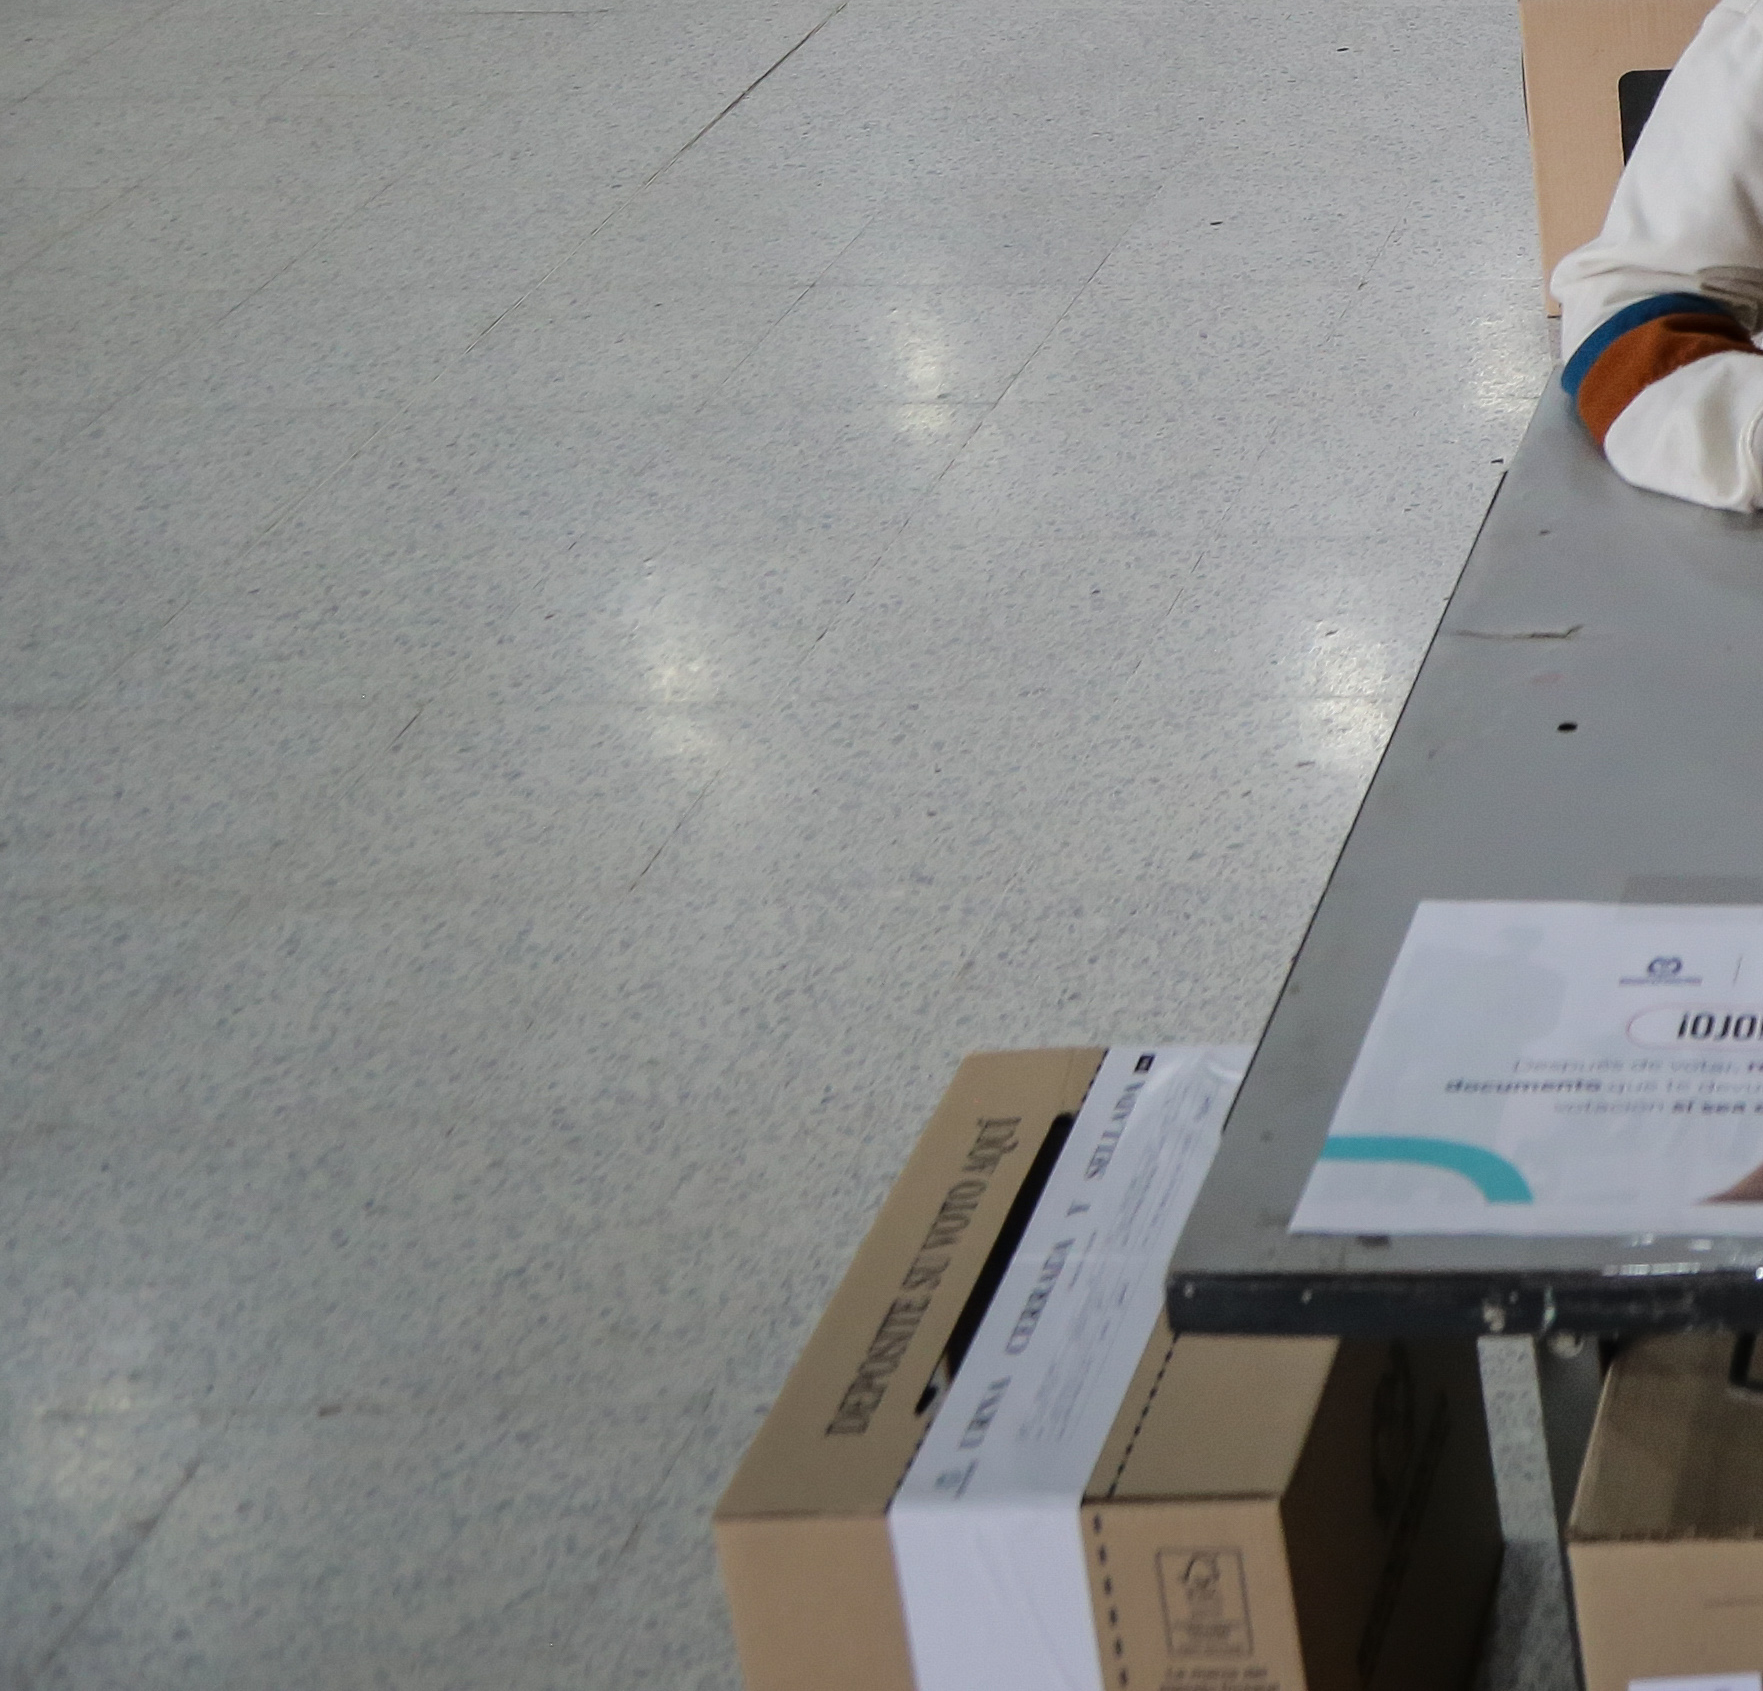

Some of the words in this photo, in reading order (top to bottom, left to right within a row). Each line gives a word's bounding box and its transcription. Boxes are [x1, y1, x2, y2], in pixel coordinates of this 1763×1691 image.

[1445, 1077, 1601, 1094] documento
[920, 1178, 988, 1252] VOTO
[1005, 1237, 1076, 1357] CERRADA
[1085, 1079, 1146, 1181] SELLADA
[901, 1256, 952, 1292] SU
[825, 1293, 932, 1438] DEPOSITE
